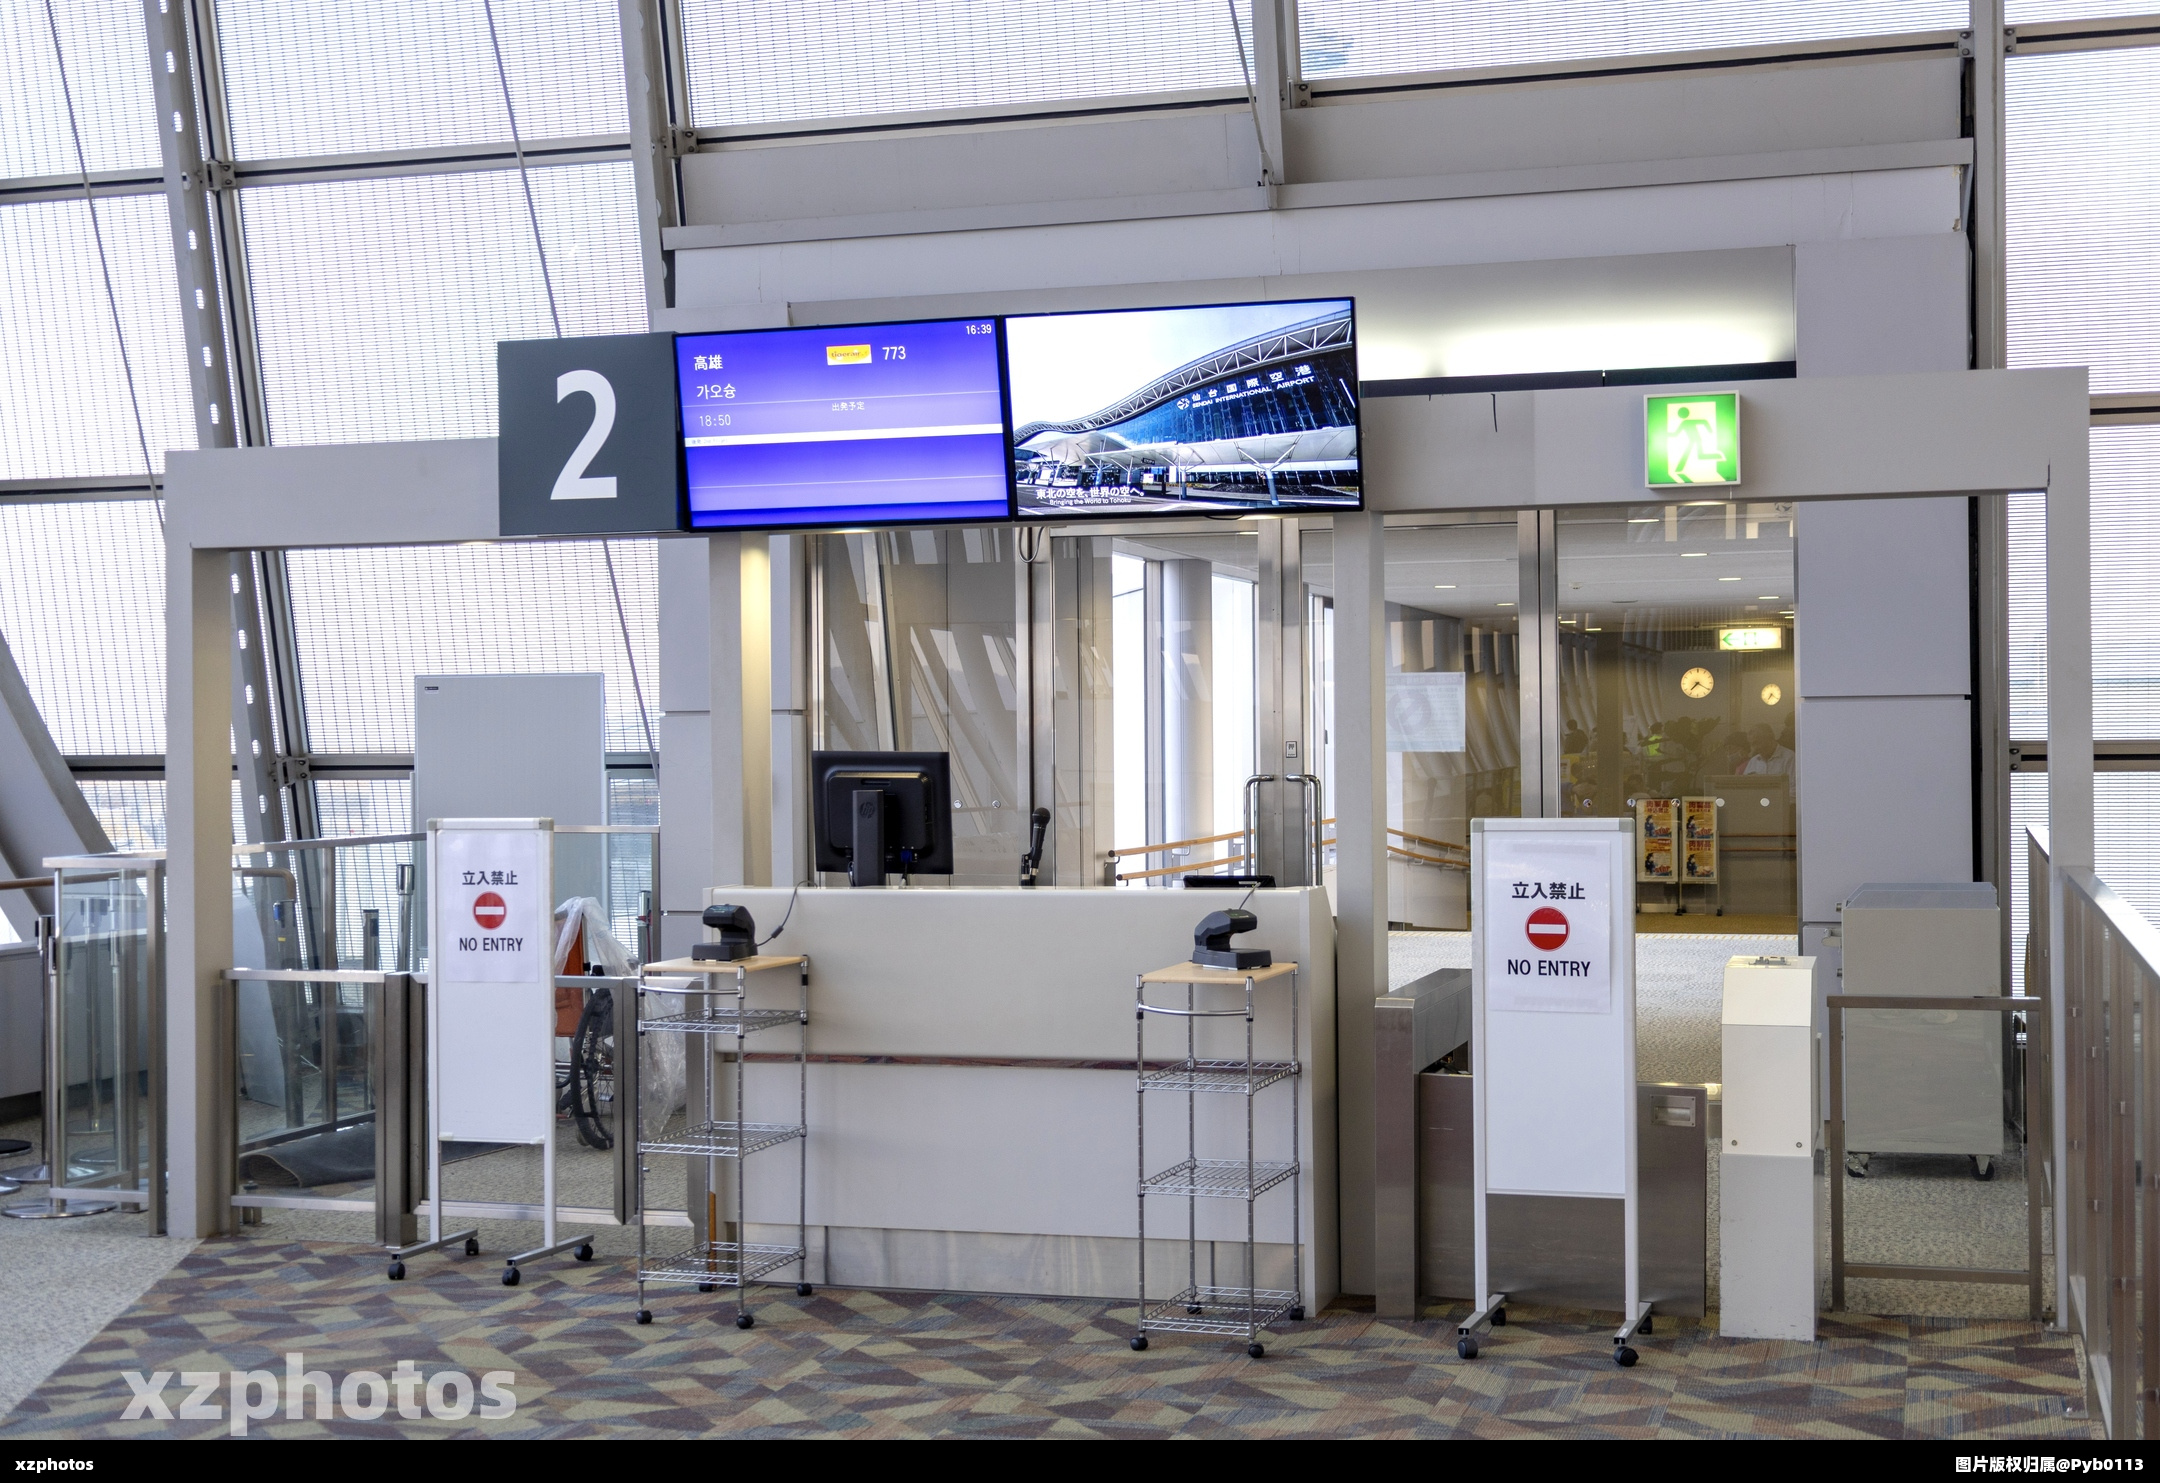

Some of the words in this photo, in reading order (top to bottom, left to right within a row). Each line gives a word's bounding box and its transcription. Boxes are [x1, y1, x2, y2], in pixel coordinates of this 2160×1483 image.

[966, 324, 992, 335] 16:39
[882, 346, 906, 360] 773
[693, 354, 724, 371] 高雄
[696, 383, 736, 400] 가오슝
[1192, 399, 1214, 408] SENDAI
[1215, 386, 1272, 403] INTERNATIONAL
[1276, 375, 1315, 390] AIRPORT
[832, 401, 865, 411] 出発予定
[699, 414, 731, 427] 18:50
[550, 369, 617, 500] 2
[1036, 486, 1145, 499] 東北の空を、世界の空へ。
[462, 870, 518, 885] 立入禁止
[1511, 881, 1586, 900] 立入禁止
[459, 937, 478, 952] NO
[483, 937, 524, 952] ENTRY
[1507, 959, 1531, 976] NO
[1538, 960, 1591, 977] ENTRY
